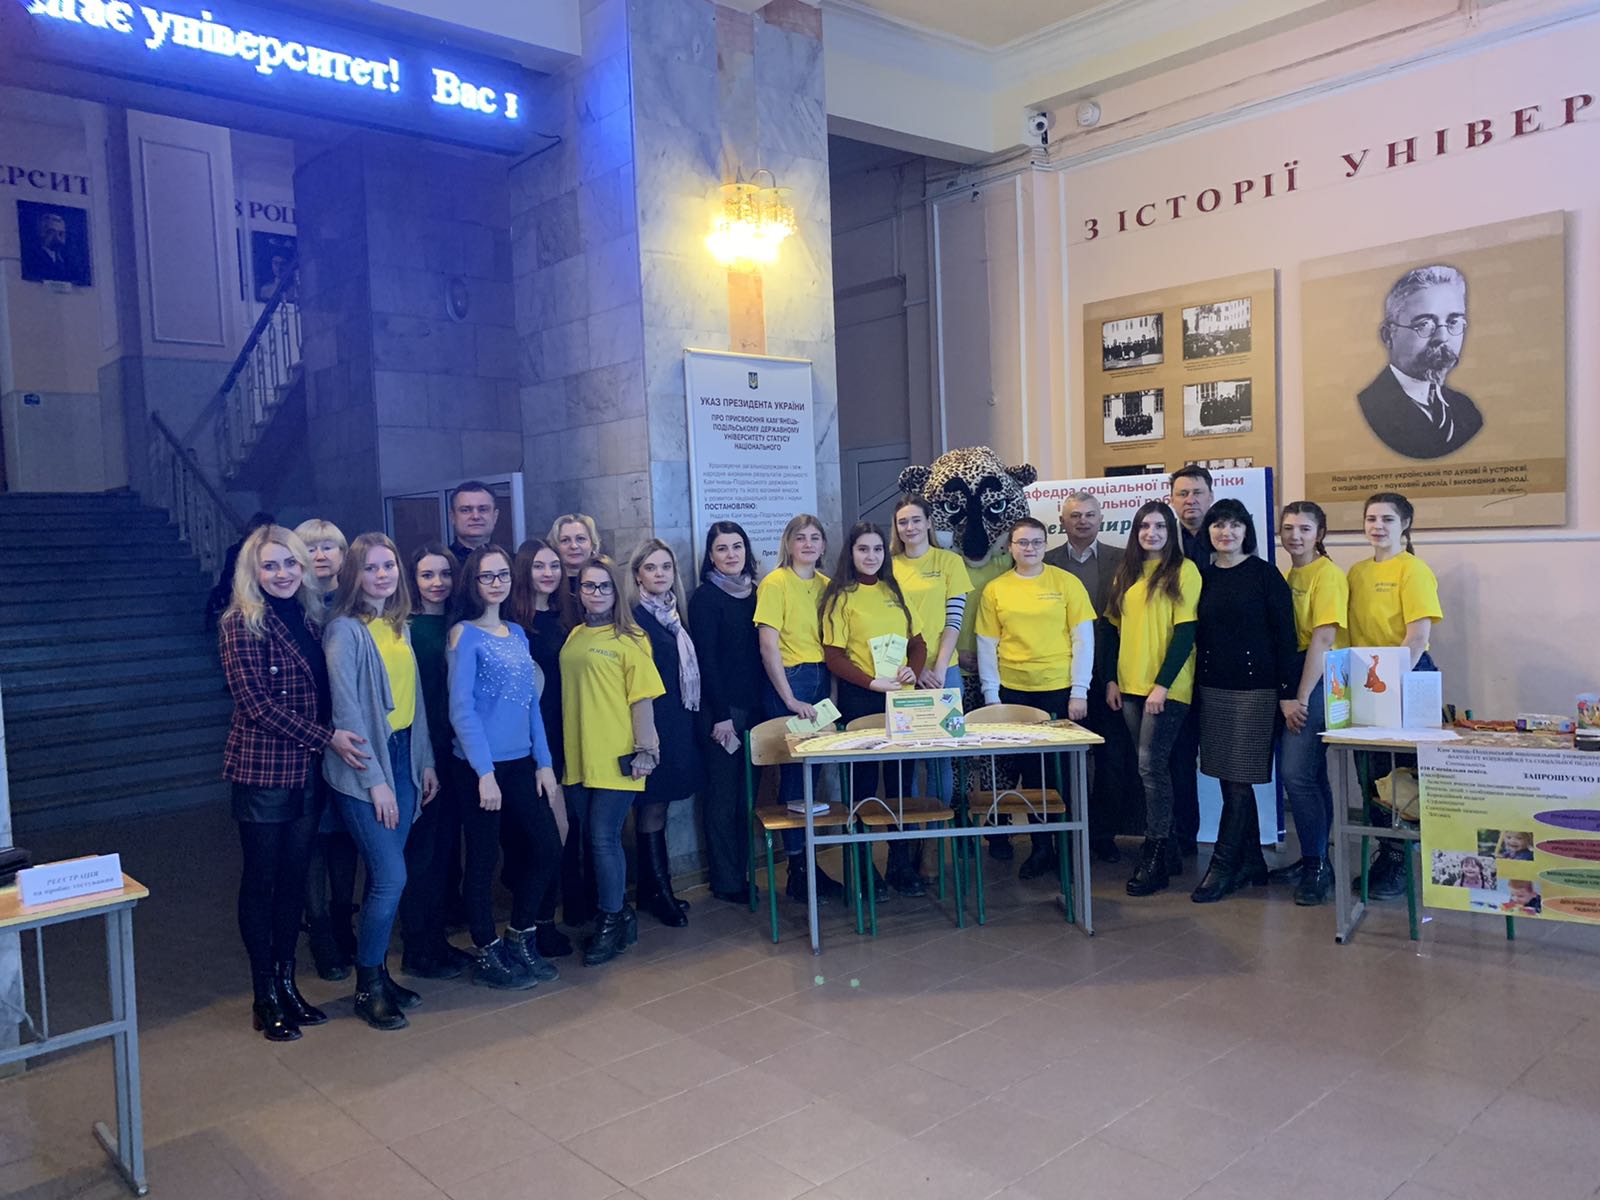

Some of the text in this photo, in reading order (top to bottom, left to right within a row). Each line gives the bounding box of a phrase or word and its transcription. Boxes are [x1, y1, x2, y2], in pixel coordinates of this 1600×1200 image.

[140, 6, 400, 93] університет!
[432, 68, 498, 114] Вас
[1083, 93, 1596, 241] З ІСТОРІЇ УНІВЕР
[700, 397, 804, 411] УКАЗ ПРЕЗИДЕНТА УКРАЇНИ
[725, 415, 765, 423] ПРИСВОЄННЯ
[713, 424, 759, 432] ПОДІЛЬСЬКОМУ
[735, 443, 781, 451] НАЦІОНАЛЬНОГО
[1349, 473, 1393, 482] університет
[1395, 471, 1441, 481] український
[1454, 468, 1481, 477] духові
[1023, 487, 1077, 501] афедра
[1080, 478, 1158, 496] соціальної
[1385, 481, 1420, 490] науковий
[1421, 479, 1448, 488] дослід
[1453, 478, 1496, 486] виховання
